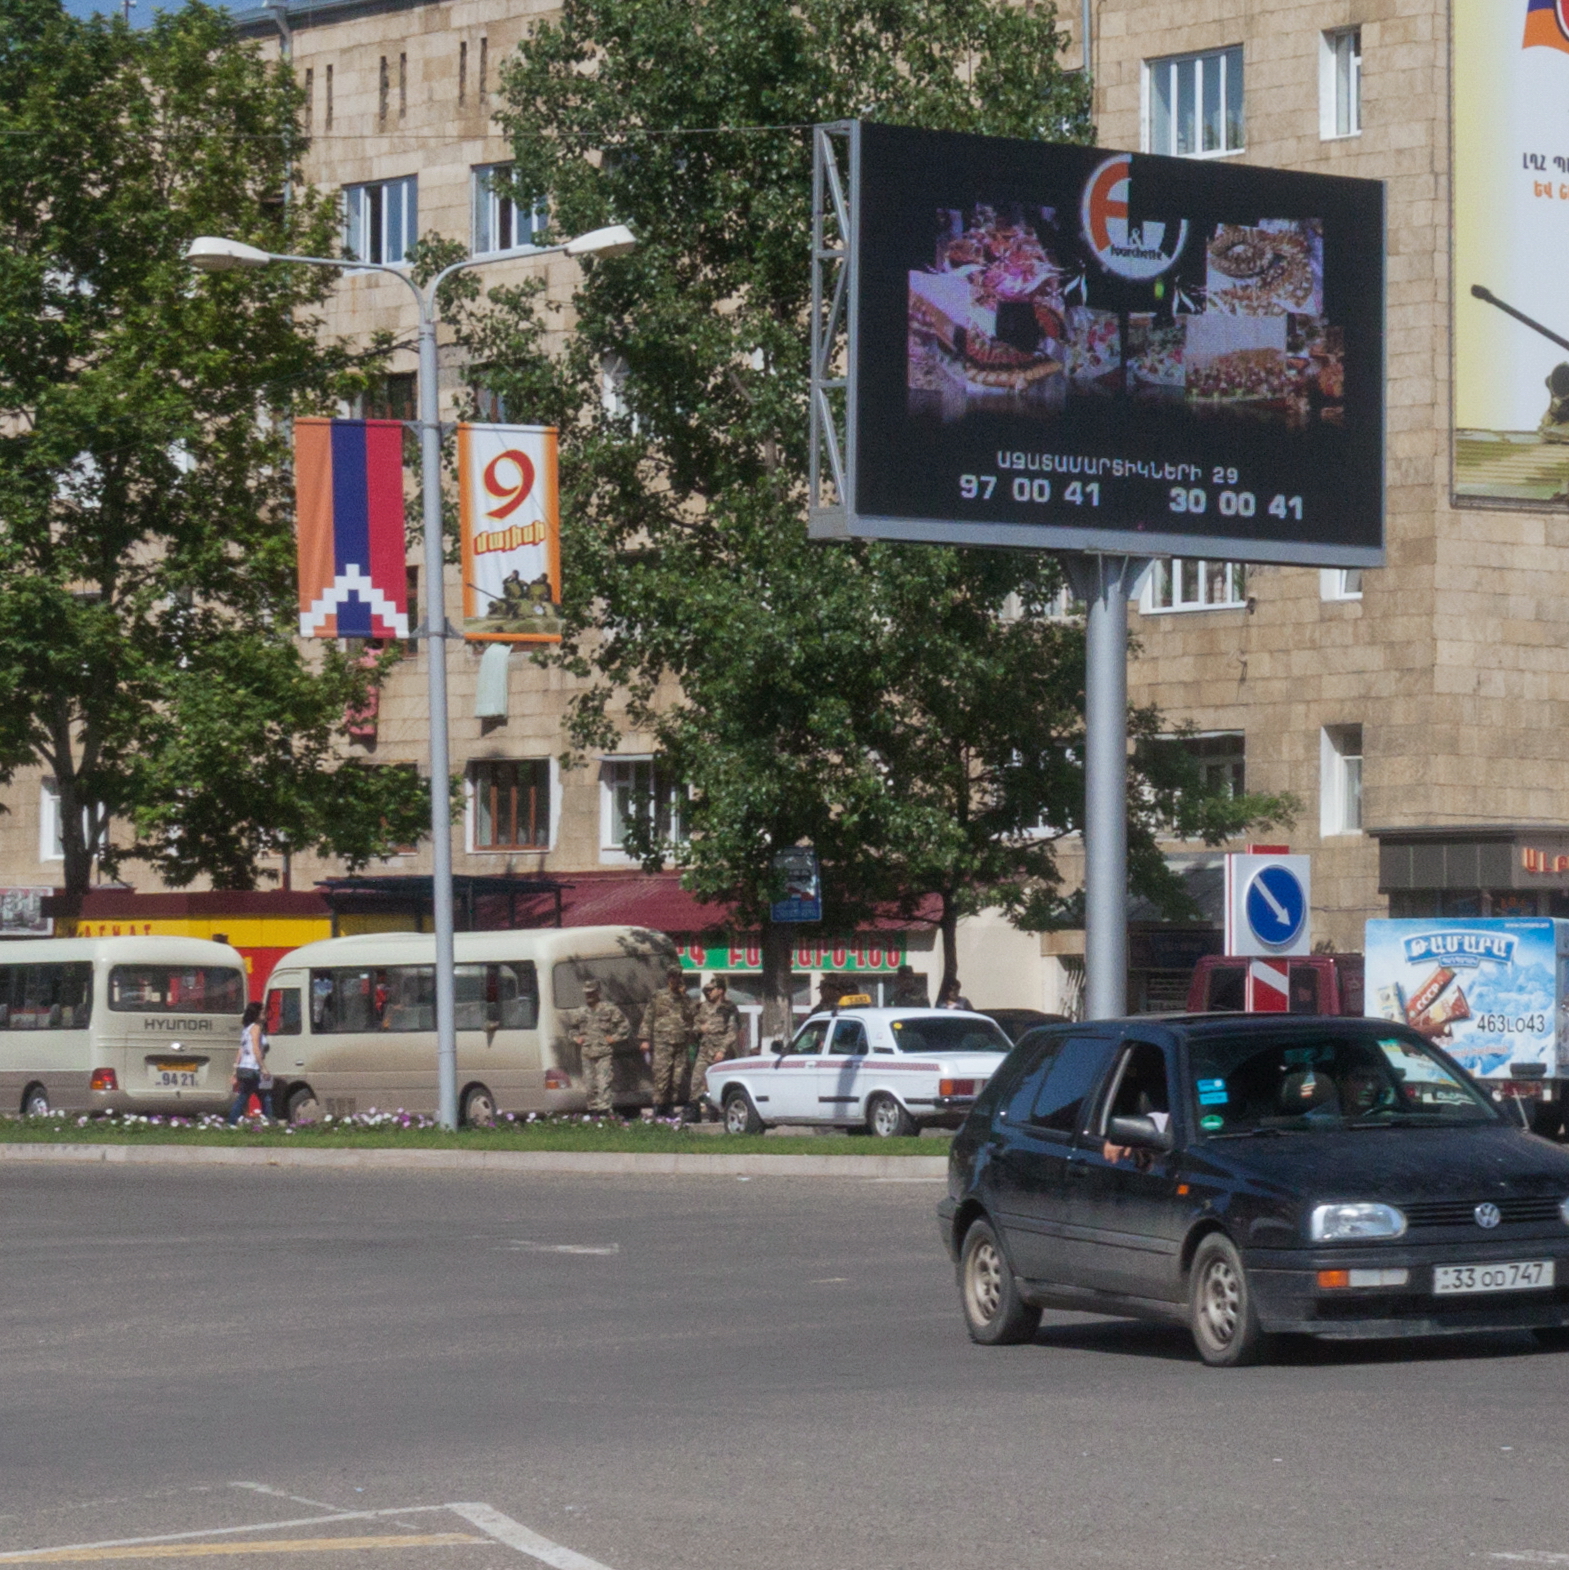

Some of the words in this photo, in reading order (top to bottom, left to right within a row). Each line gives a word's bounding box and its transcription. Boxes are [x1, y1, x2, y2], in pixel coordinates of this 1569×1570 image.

[996, 450, 1202, 481] ԱԶԱՏԱՄԱՐՏԻԿՆԵՐԻ
[1212, 466, 1239, 485] 29
[483, 449, 536, 520] 9
[959, 474, 997, 500] 97
[1012, 478, 1051, 503] 00
[1063, 481, 1100, 507] 41
[1169, 487, 1207, 513] 30
[1218, 491, 1256, 517] 00
[1268, 495, 1304, 520] 41
[144, 1018, 213, 1031] HYUNDAI
[1452, 1268, 1476, 1289] 33
[1481, 1270, 1506, 1287] OD
[1508, 1263, 1544, 1286] 747
